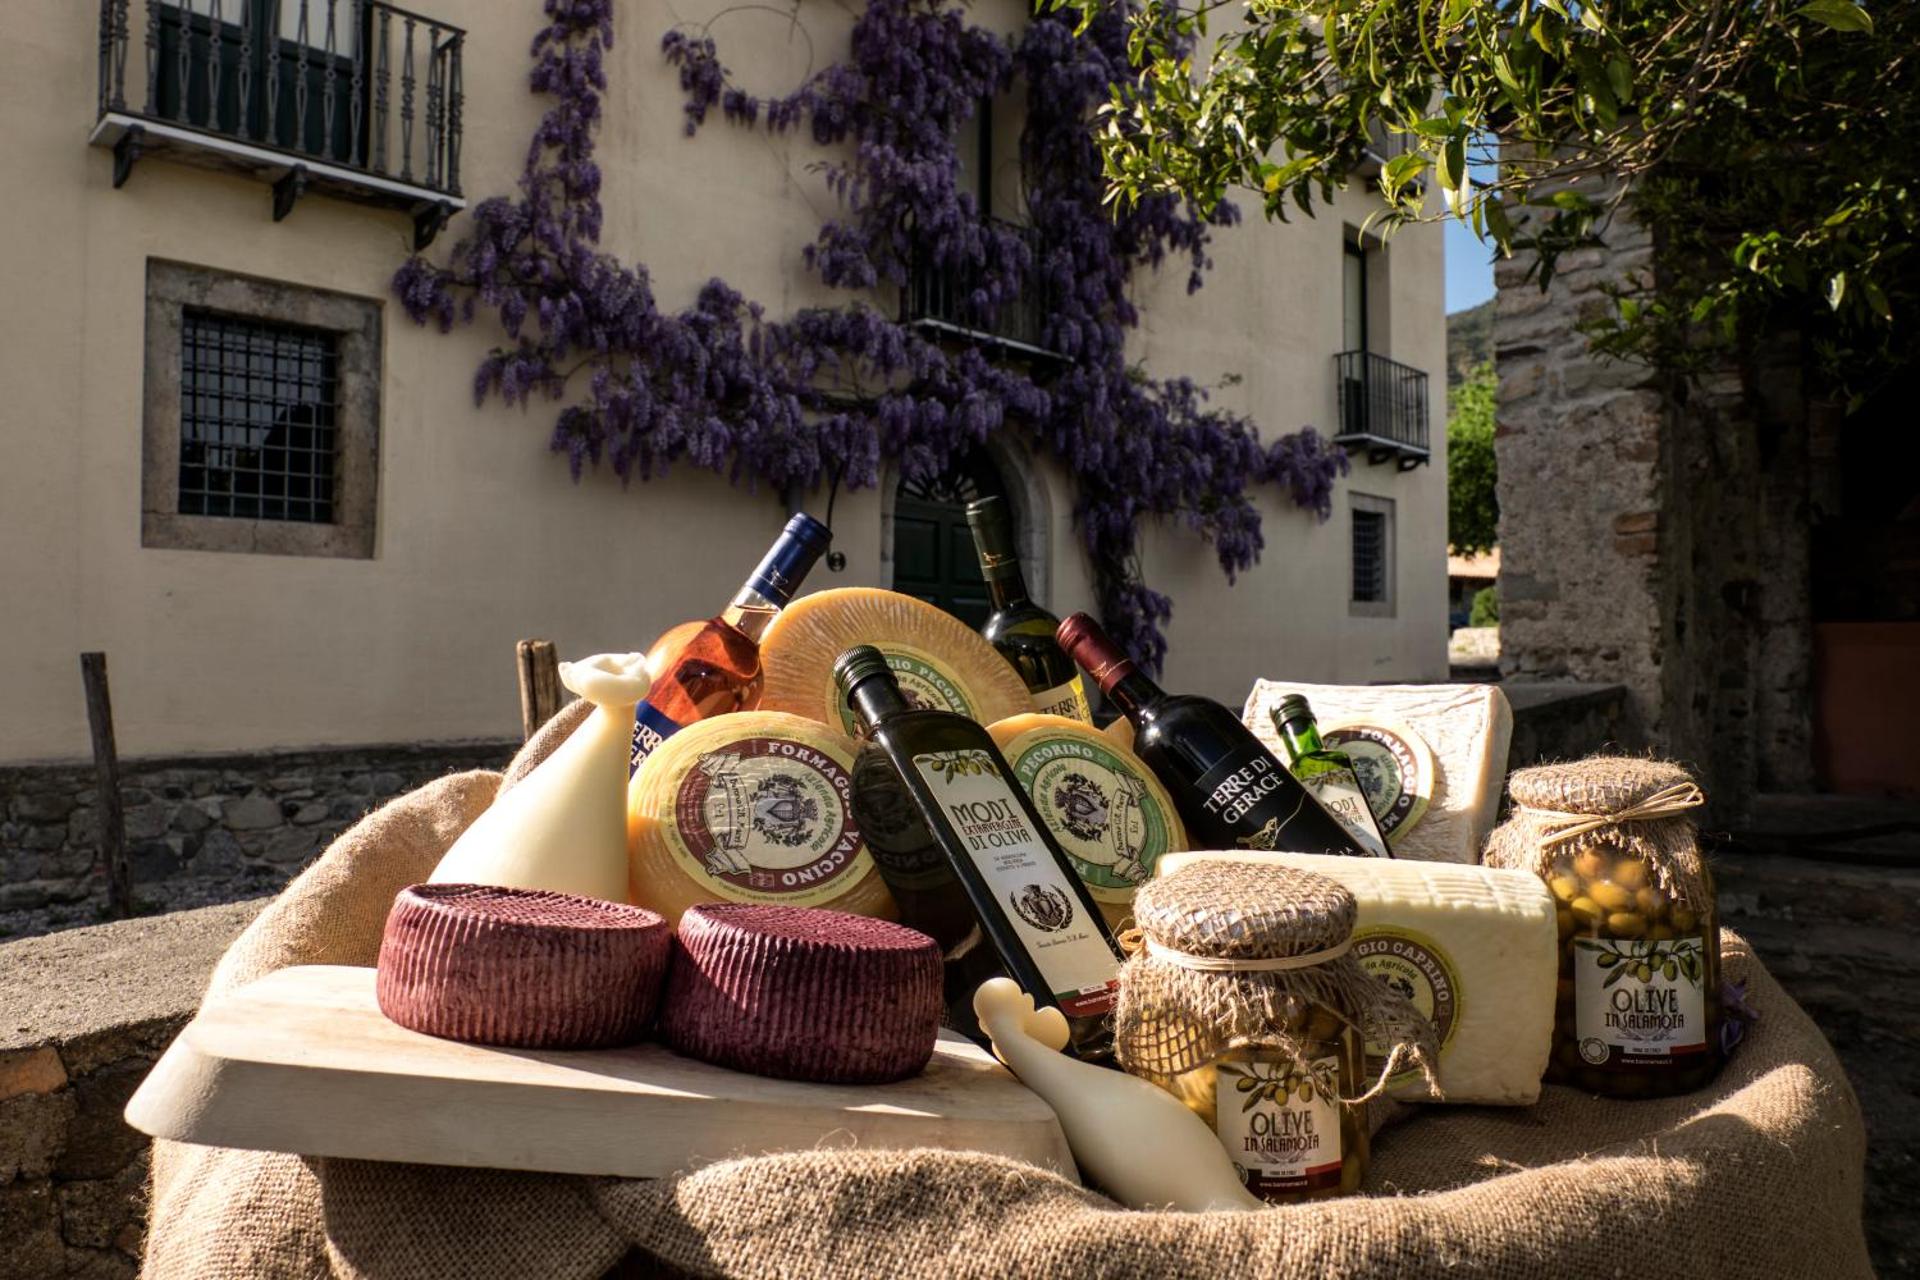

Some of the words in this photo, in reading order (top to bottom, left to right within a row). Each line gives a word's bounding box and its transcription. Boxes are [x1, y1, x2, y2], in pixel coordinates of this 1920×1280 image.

[1021, 743, 1093, 776] PECORINO
[1203, 767, 1254, 815] TERRE
[1251, 755, 1272, 775] DI
[1223, 772, 1284, 824] GERACE
[949, 798, 1018, 826] MODI
[962, 818, 1024, 836] EXTRAVERGINE
[968, 835, 989, 851] DI
[988, 828, 1032, 848] OLIVA
[782, 830, 860, 886] VACCINO
[1392, 942, 1450, 1001] CAPRINO
[1612, 988, 1678, 1013] OLIVE
[1605, 1012, 1620, 1028] IN
[1623, 1014, 1684, 1030] SALAMOIA
[1251, 1110, 1314, 1137] OLIVE
[1244, 1136, 1258, 1152] IN
[1261, 1135, 1320, 1153] SALAMOIA
